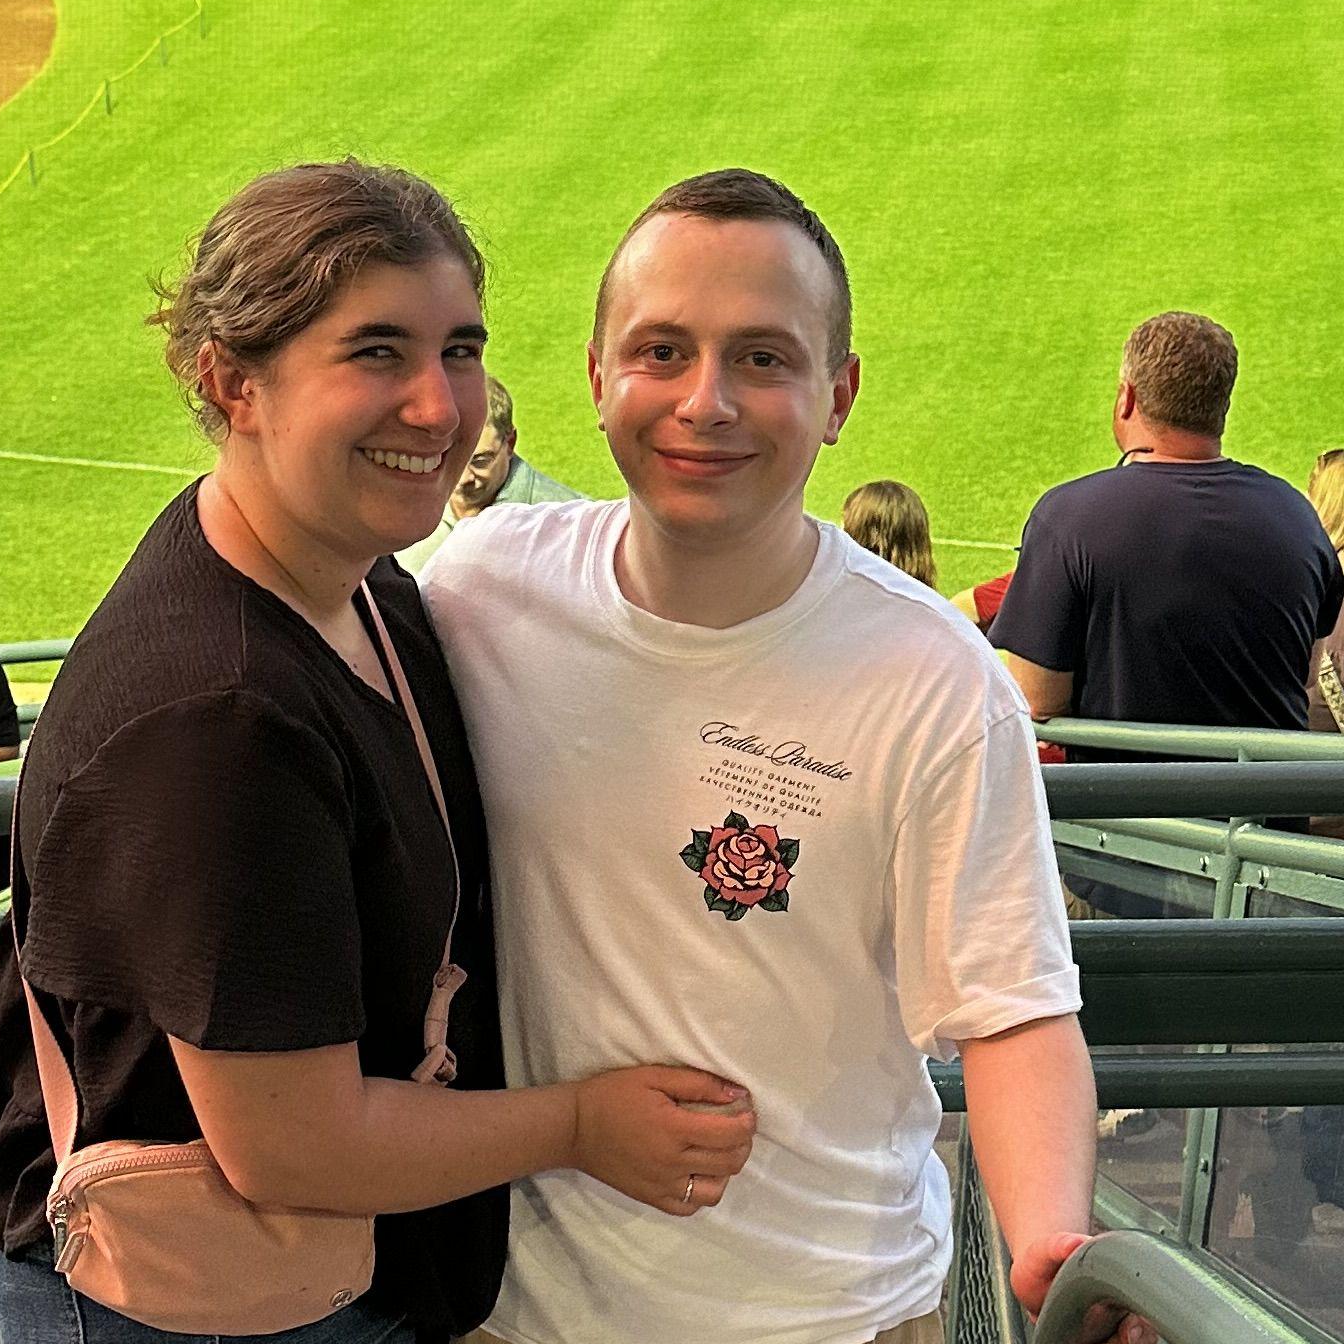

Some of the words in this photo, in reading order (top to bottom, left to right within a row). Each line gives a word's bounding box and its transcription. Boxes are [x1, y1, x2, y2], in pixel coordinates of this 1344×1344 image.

[699, 721, 772, 757] Endless
[764, 740, 853, 782] Paradise
[761, 782, 775, 792] DE
[767, 772, 816, 793] GARMENT
